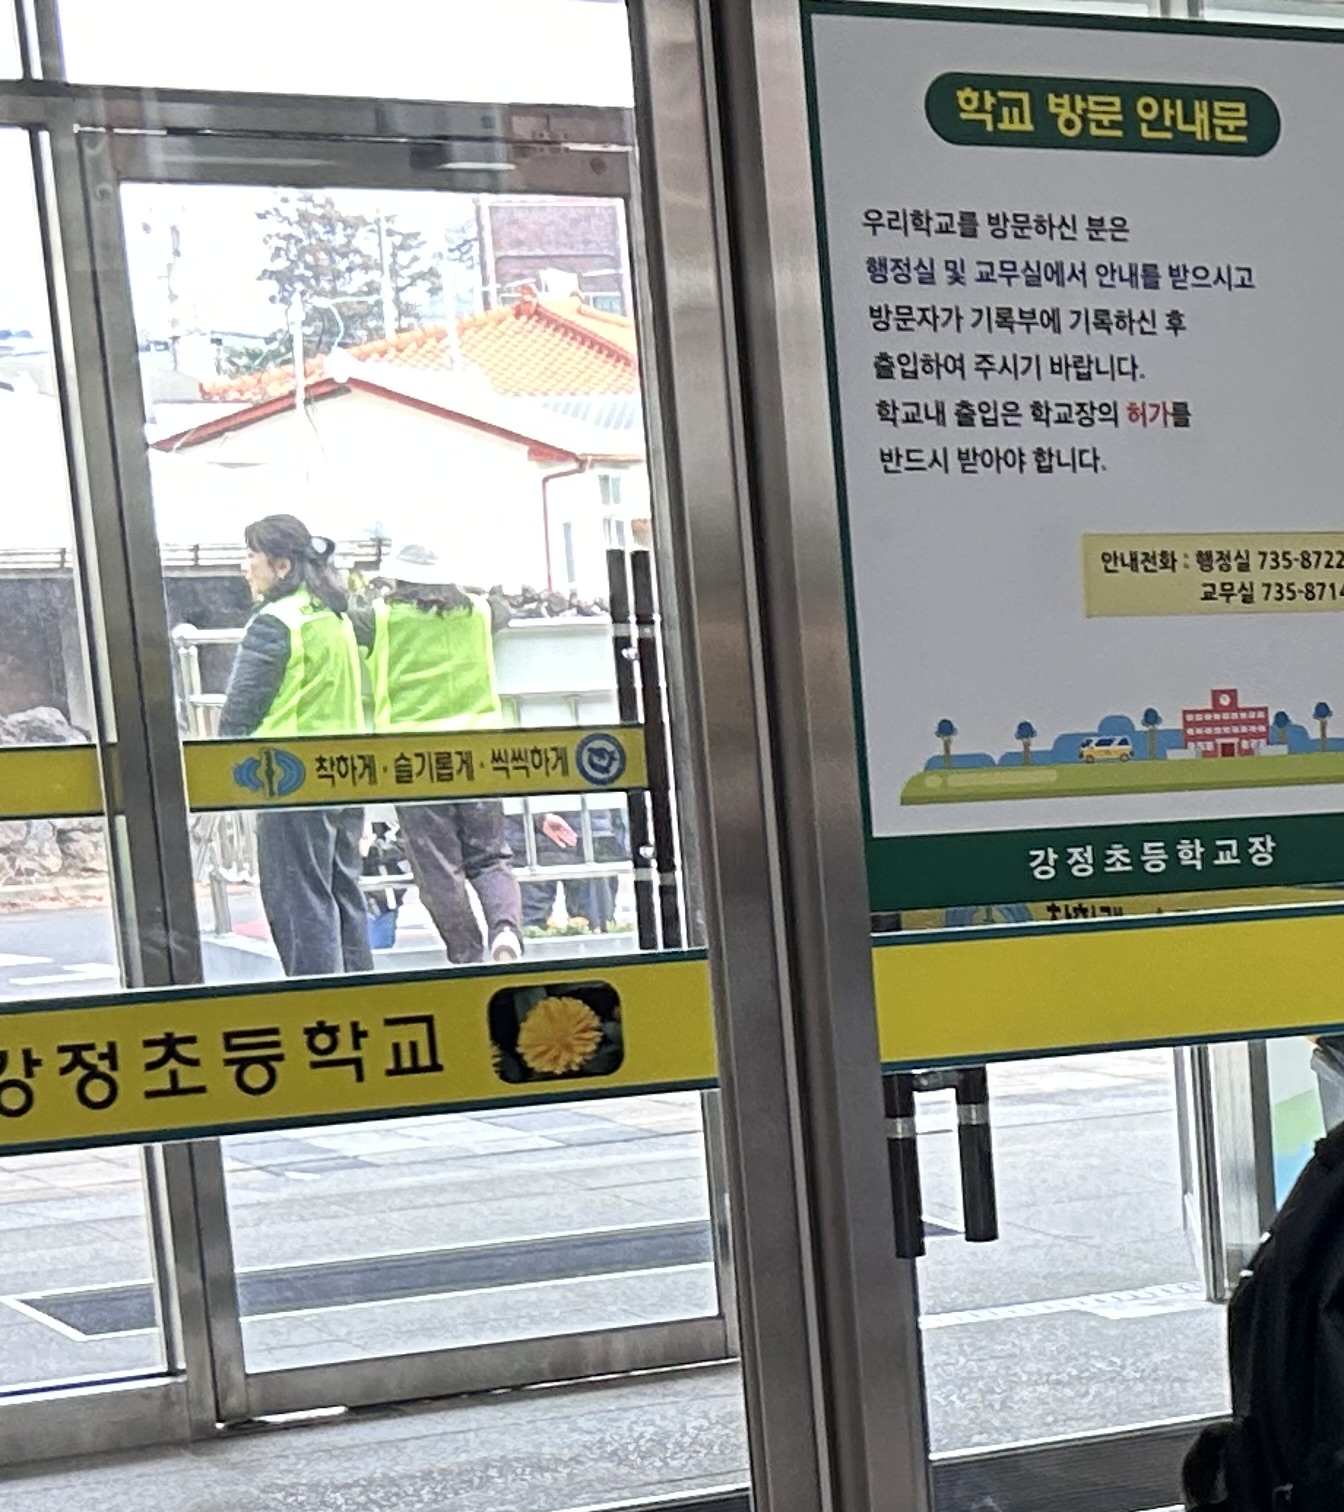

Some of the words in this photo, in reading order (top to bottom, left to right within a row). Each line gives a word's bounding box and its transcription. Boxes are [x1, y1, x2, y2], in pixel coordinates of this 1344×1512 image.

[956, 87, 1035, 132] 학교
[1047, 92, 1124, 138] 방문
[1136, 96, 1248, 143] 안내문
[861, 208, 980, 239] 우리학교를
[986, 211, 1078, 242] 방문하신
[1085, 215, 1130, 243] 분은
[865, 256, 937, 286] 행정실
[944, 257, 967, 287] 및
[974, 259, 1088, 289] 교무실에서
[1095, 261, 1162, 291] 안내를
[1167, 263, 1256, 292] 받으시고
[868, 303, 964, 334] 방문자가
[970, 305, 1062, 335] 기록부에
[1069, 307, 1158, 337] 기록하신
[1165, 309, 1187, 337] 후
[873, 351, 966, 381] 출입하여
[973, 353, 1042, 382] 주시기
[1049, 353, 1146, 382] 바랍니다.
[875, 399, 947, 428] 학교내
[953, 400, 1023, 428] 출입은
[1029, 400, 1119, 429] 학교장의
[1126, 401, 1192, 429] 허가를
[879, 446, 949, 475] 반드시
[957, 446, 1027, 475] 받아야
[1032, 446, 1107, 474] 합니다.
[1100, 549, 1178, 574] 안내전화
[1195, 548, 1252, 574] 행정실
[1199, 580, 1255, 605] 교무실
[315, 754, 377, 787] 착하게
[394, 750, 475, 784] 슬기롭게
[490, 745, 571, 780] 씩씩하게
[1029, 834, 1276, 880] 강정초등학교장
[0, 1013, 445, 1118] 강정초등학교
